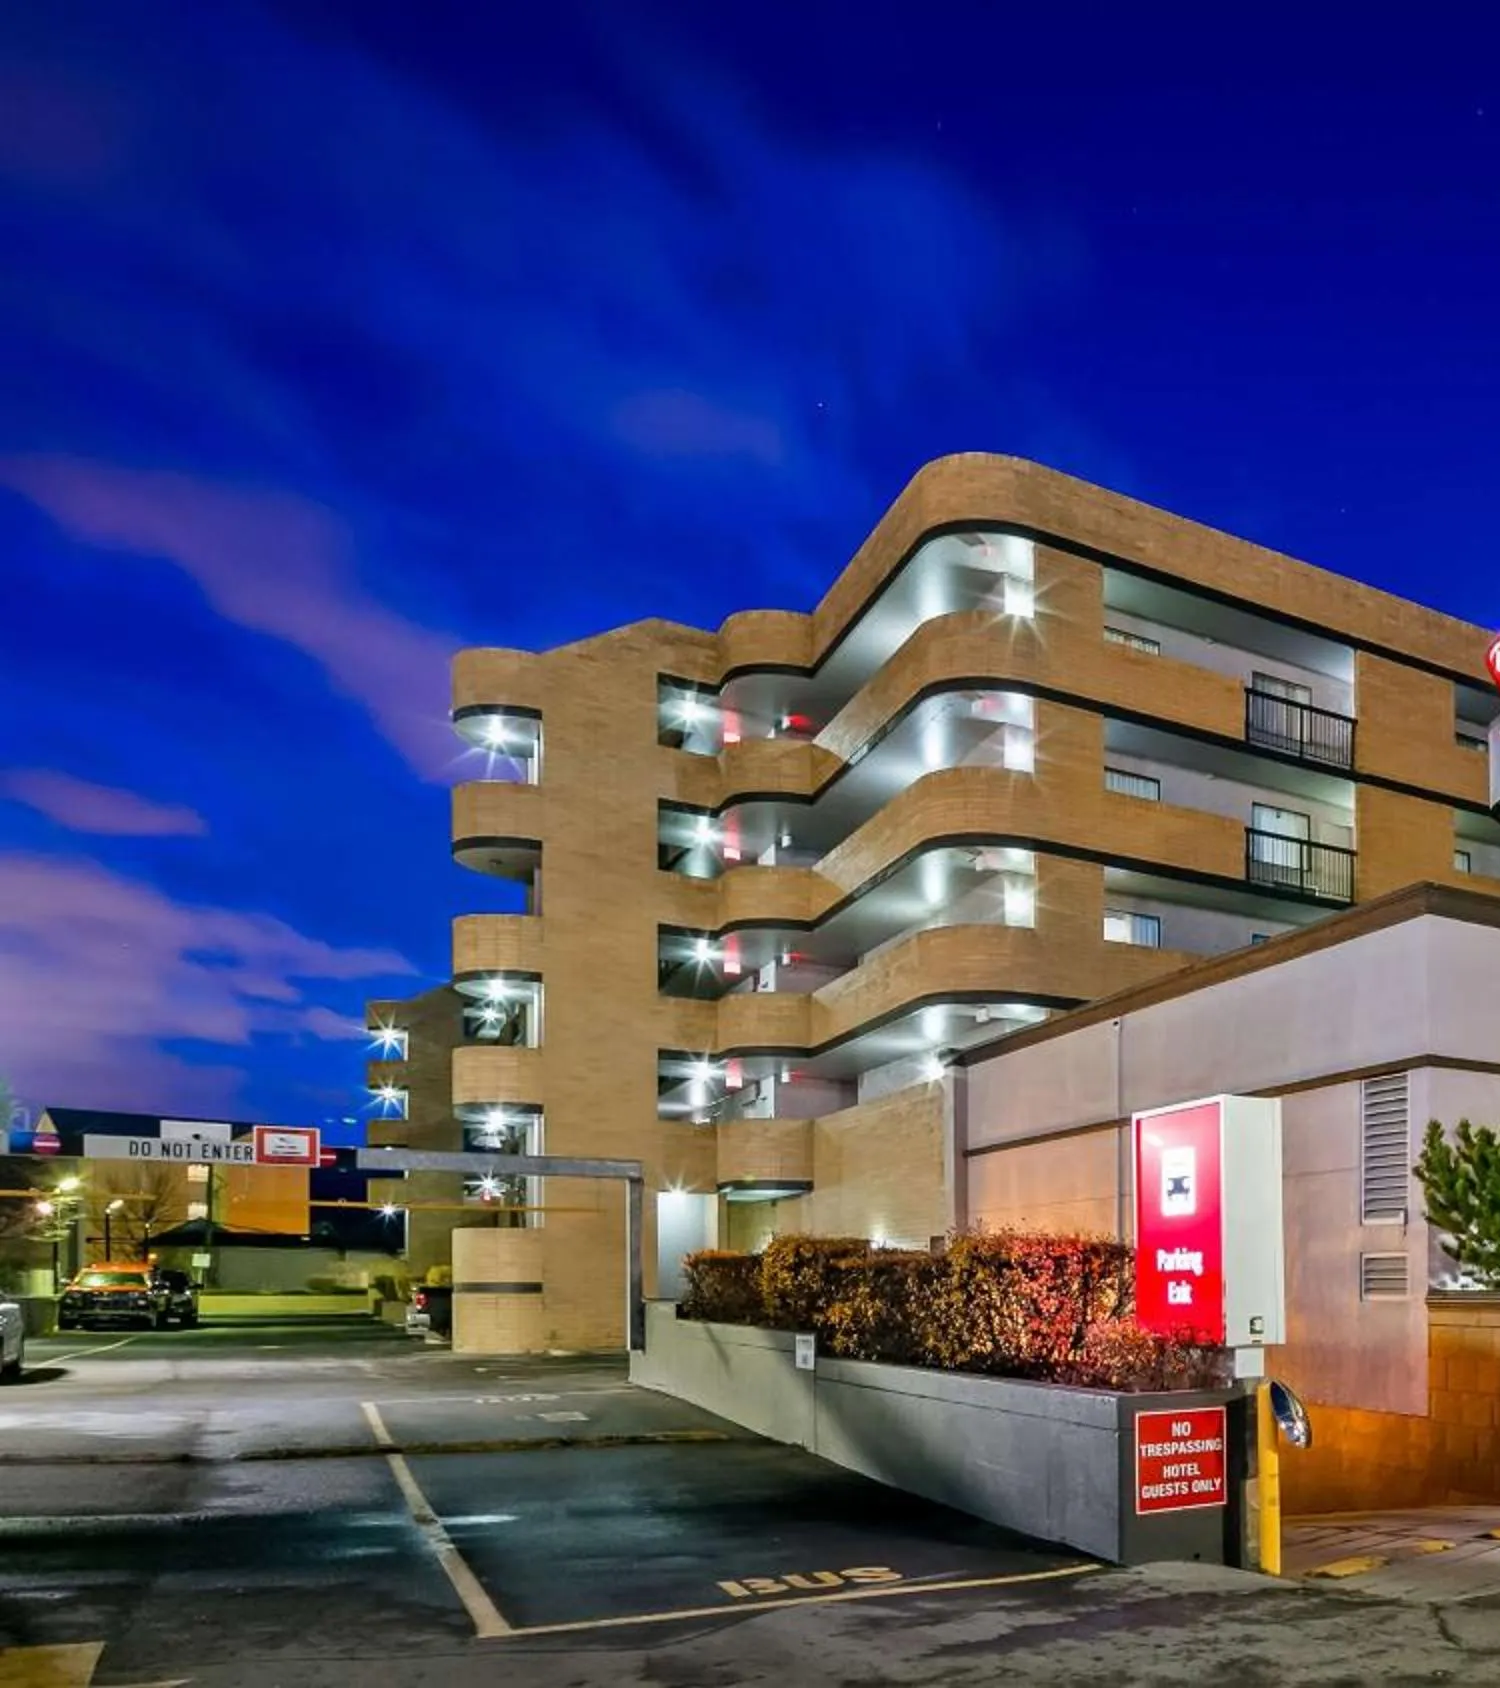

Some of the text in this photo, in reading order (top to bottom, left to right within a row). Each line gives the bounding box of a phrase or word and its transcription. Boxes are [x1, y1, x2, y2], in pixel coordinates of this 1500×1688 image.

[129, 1140, 151, 1157] DO
[161, 1143, 192, 1159] NOT
[201, 1143, 254, 1161] ENTER
[1156, 1248, 1204, 1277] Parking
[1167, 1280, 1193, 1305] Exit
[1171, 1421, 1192, 1437] NO
[1140, 1438, 1222, 1457] TRESPASSING
[1163, 1462, 1201, 1479] HOTEL
[1141, 1478, 1221, 1499] GUESTS ONLY
[716, 1566, 903, 1599] BUS
